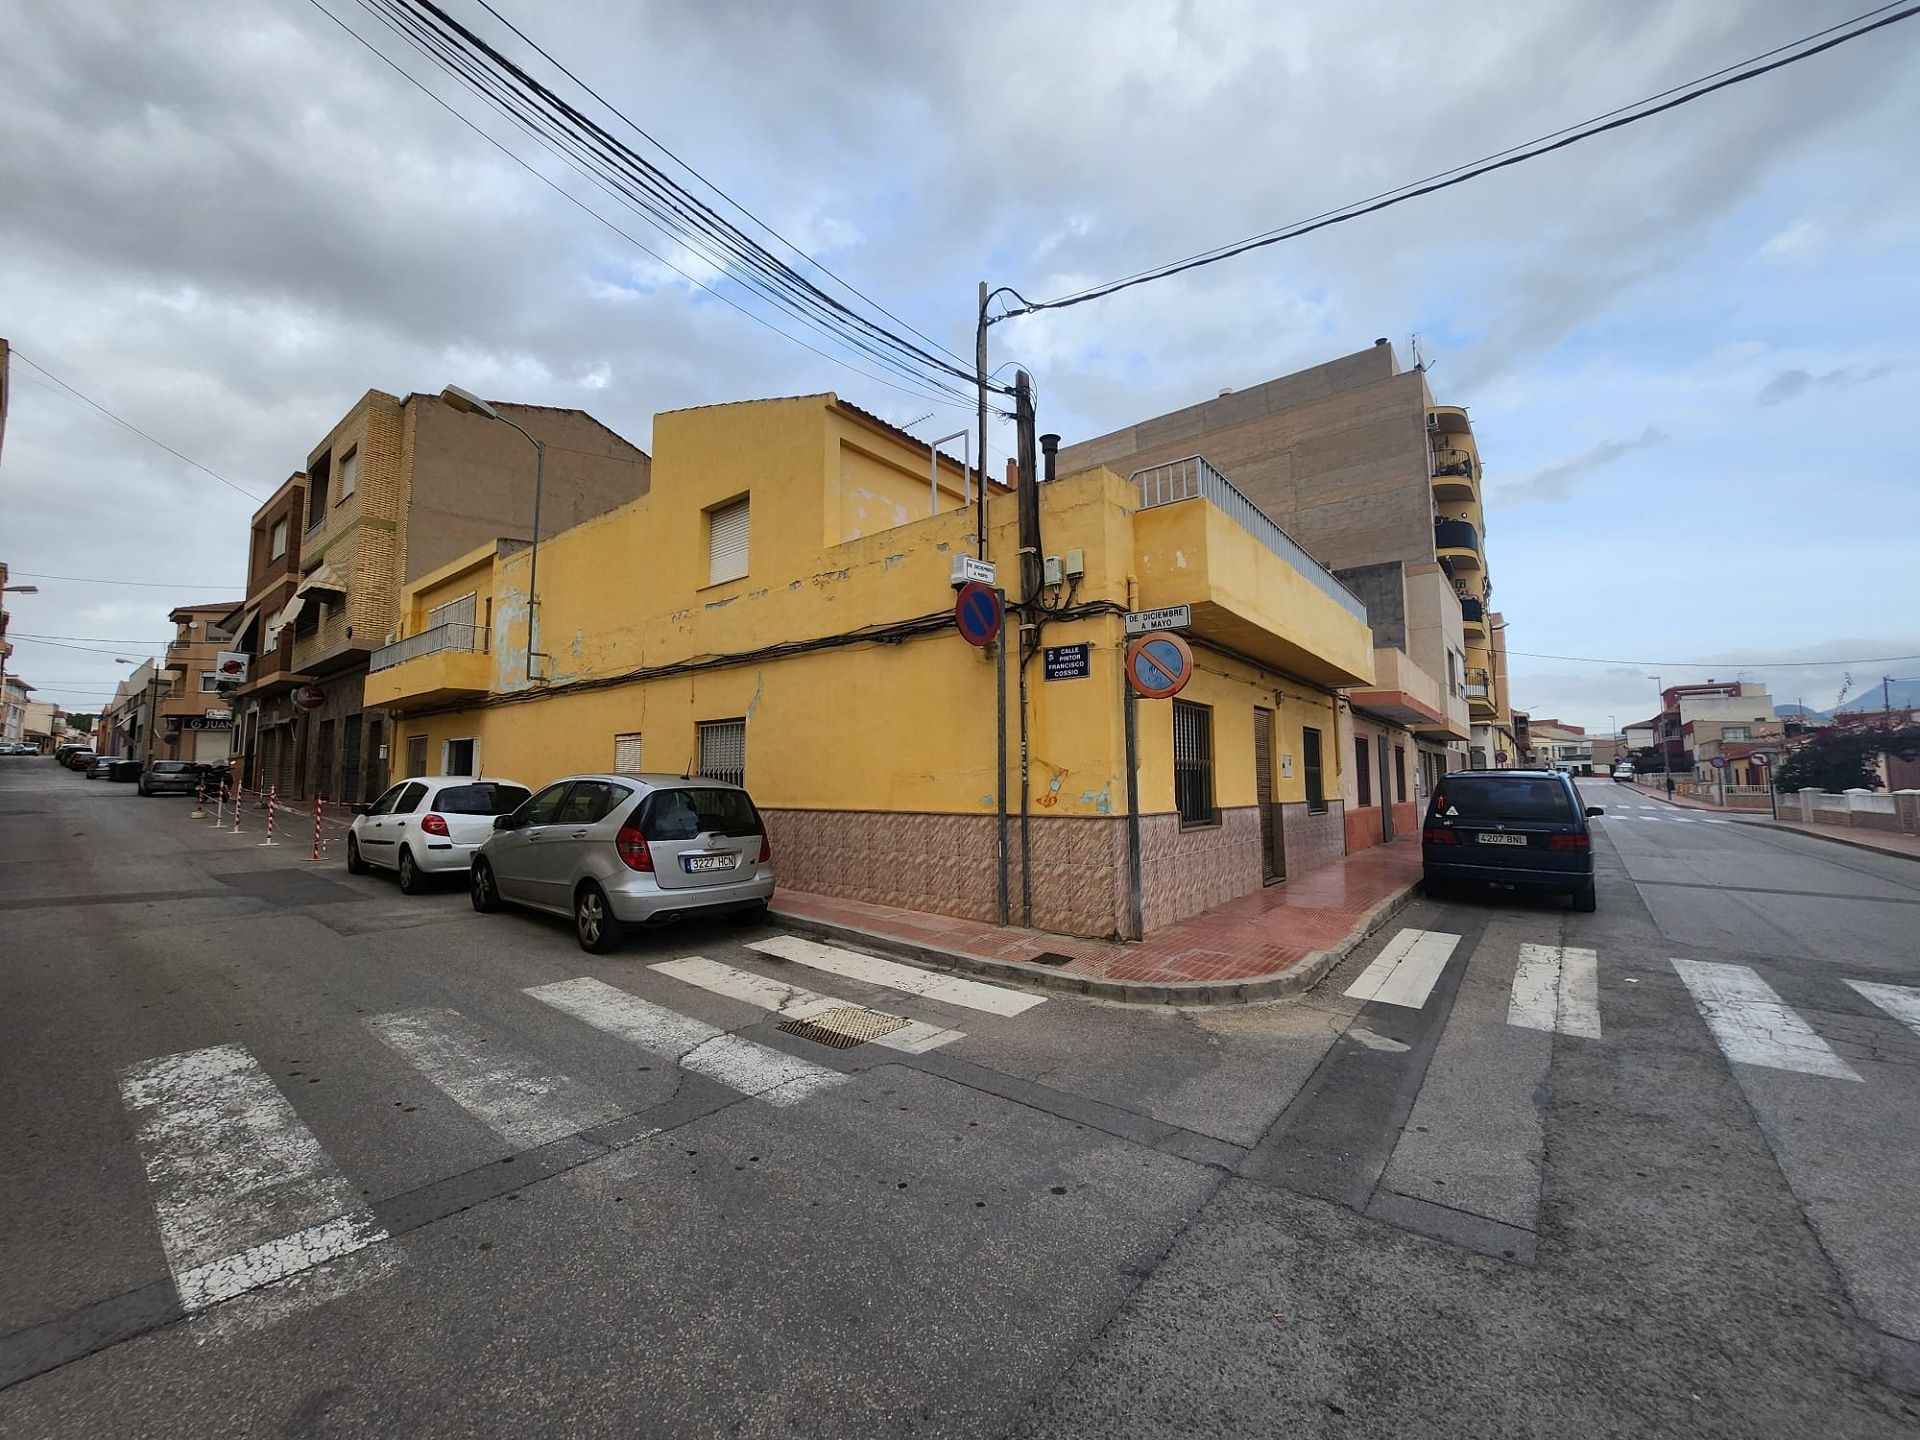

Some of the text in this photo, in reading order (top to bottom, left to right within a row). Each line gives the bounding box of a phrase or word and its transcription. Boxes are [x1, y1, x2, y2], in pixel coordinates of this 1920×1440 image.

[1129, 608, 1184, 623] DE DICIEMBRE
[1151, 619, 1172, 628] MAYO
[1060, 647, 1080, 655] CALLE
[1059, 654, 1081, 662] PINTOR
[1048, 661, 1085, 671] FRANCISCO
[1054, 669, 1079, 677] COSSIO
[1481, 834, 1526, 845] 4207 BNL
[693, 856, 734, 869] 3227 HCN
